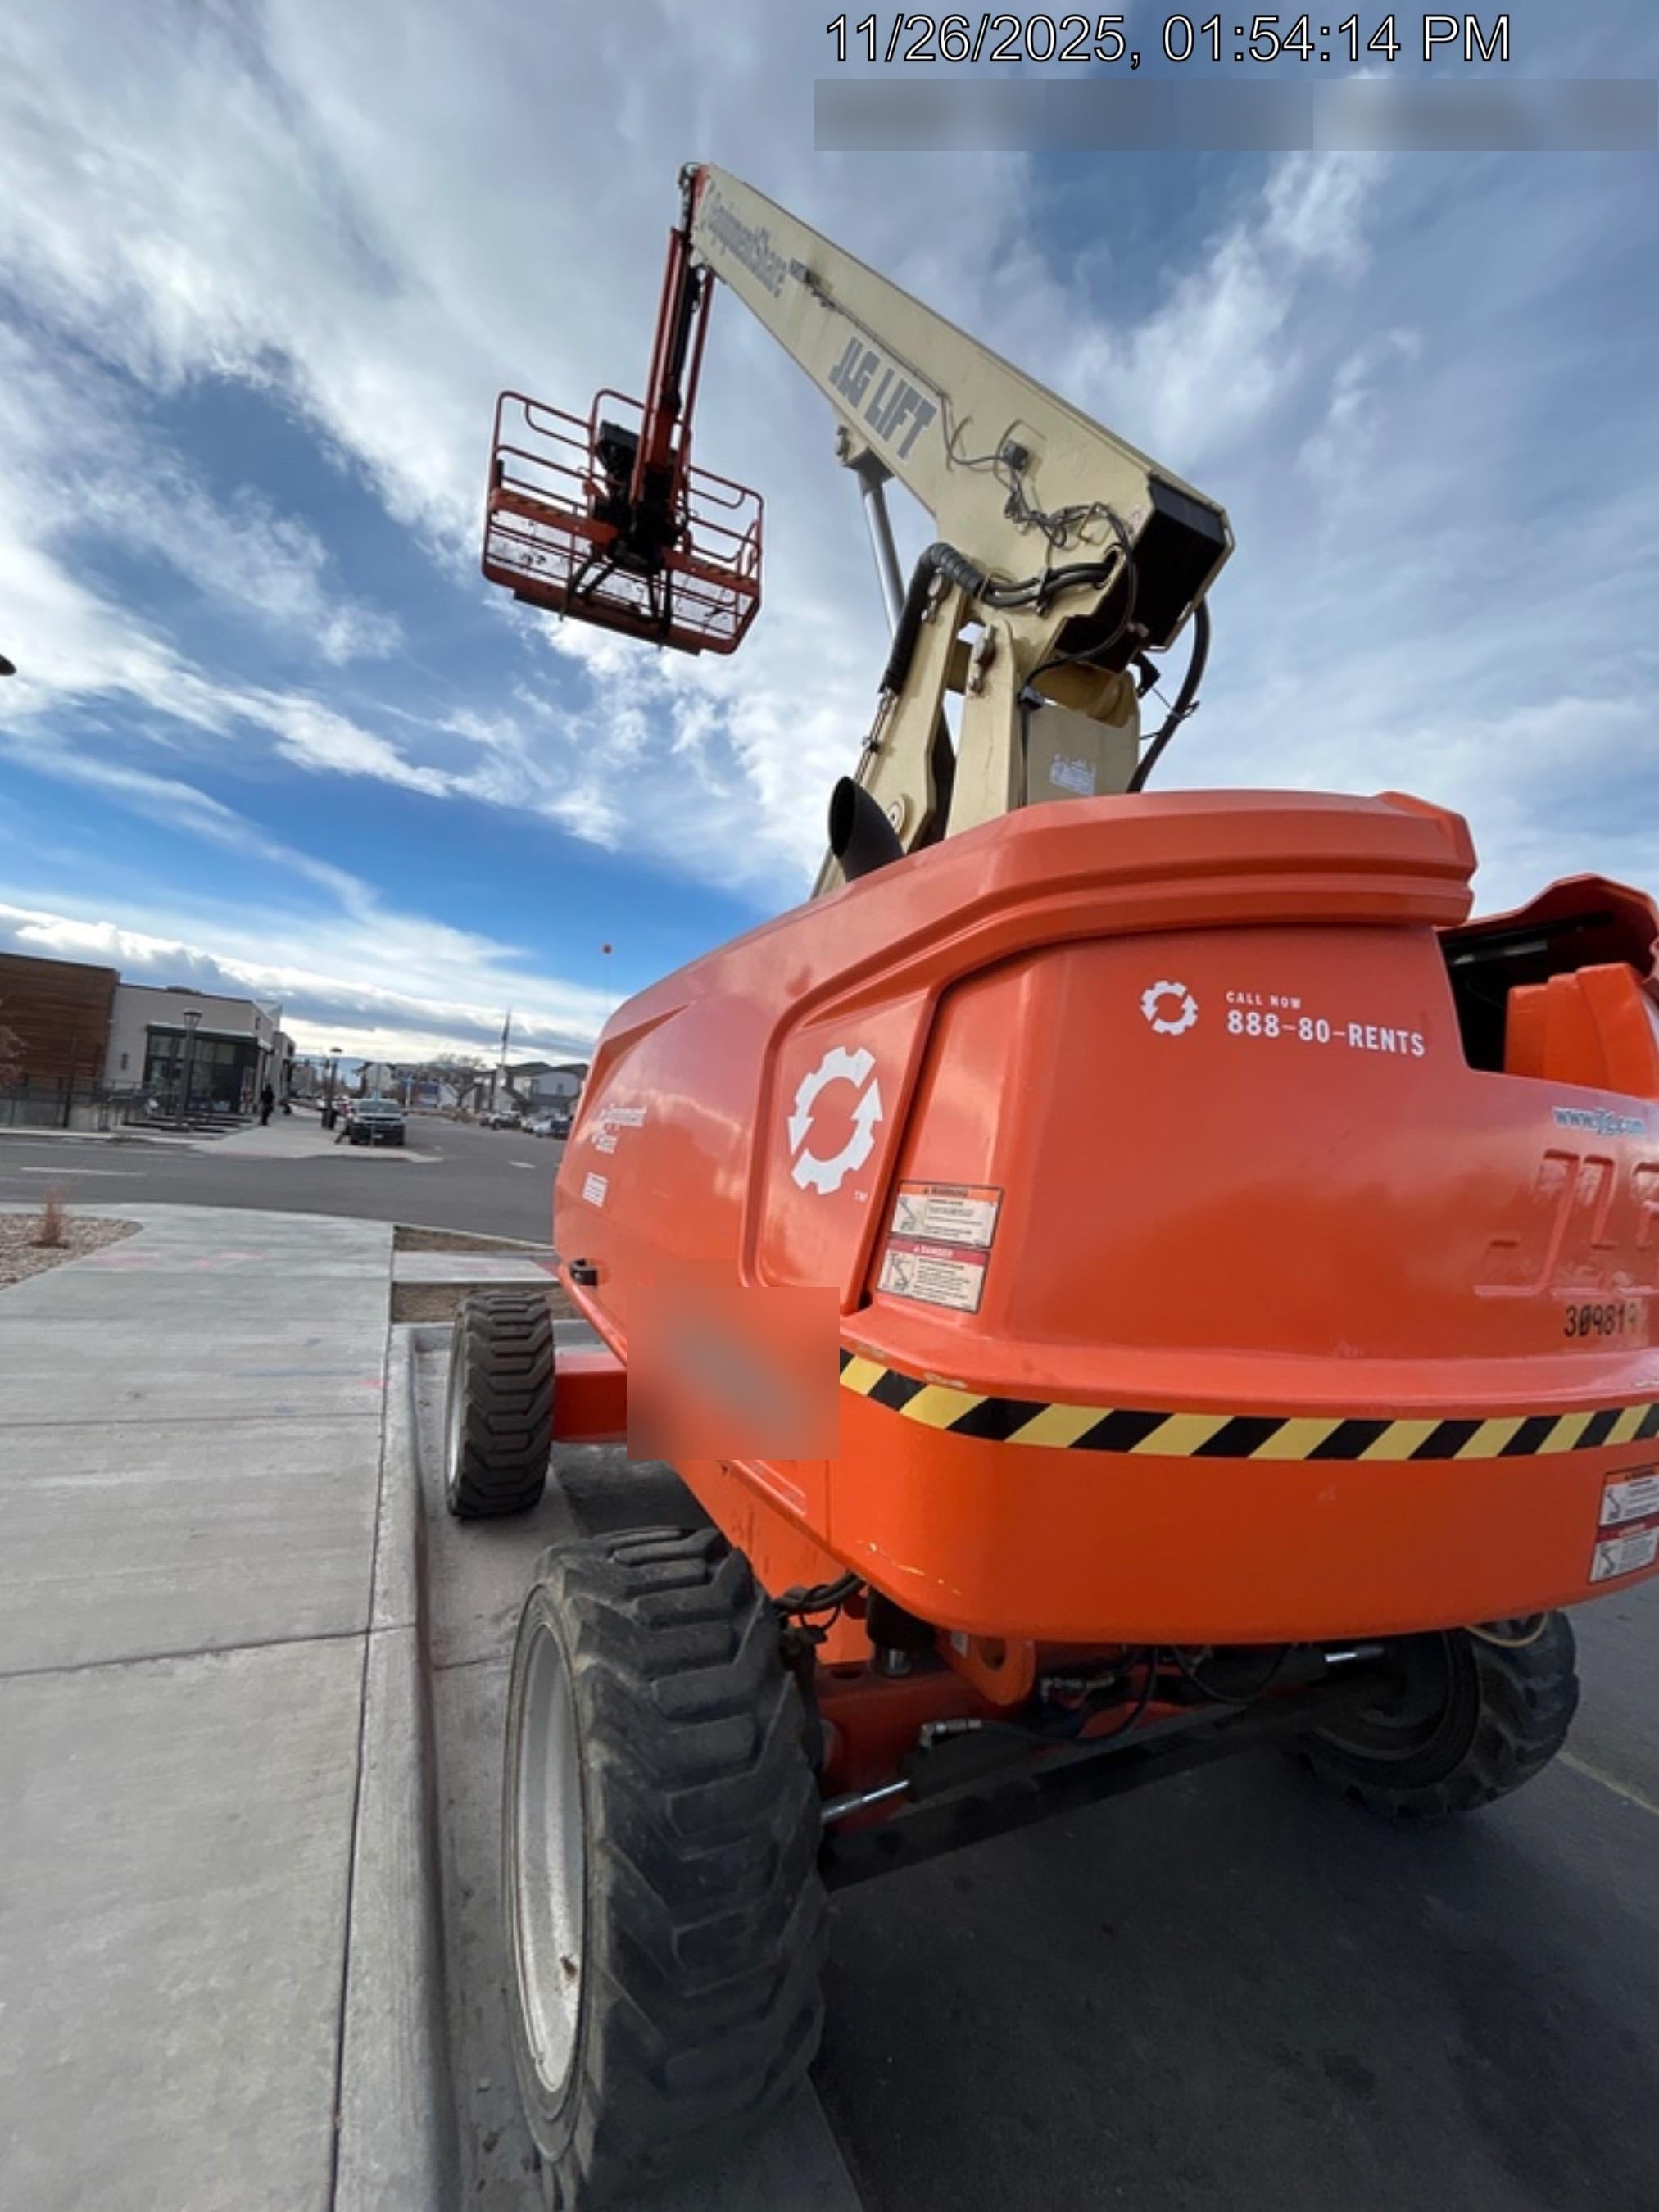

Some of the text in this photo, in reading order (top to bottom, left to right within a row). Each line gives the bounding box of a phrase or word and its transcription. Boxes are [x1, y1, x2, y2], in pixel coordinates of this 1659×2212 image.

[828, 336, 937, 460] JLG LIFT
[1226, 991, 1302, 1009] CALL NOW
[1226, 1009, 1426, 1058] 888-80-RENTS
